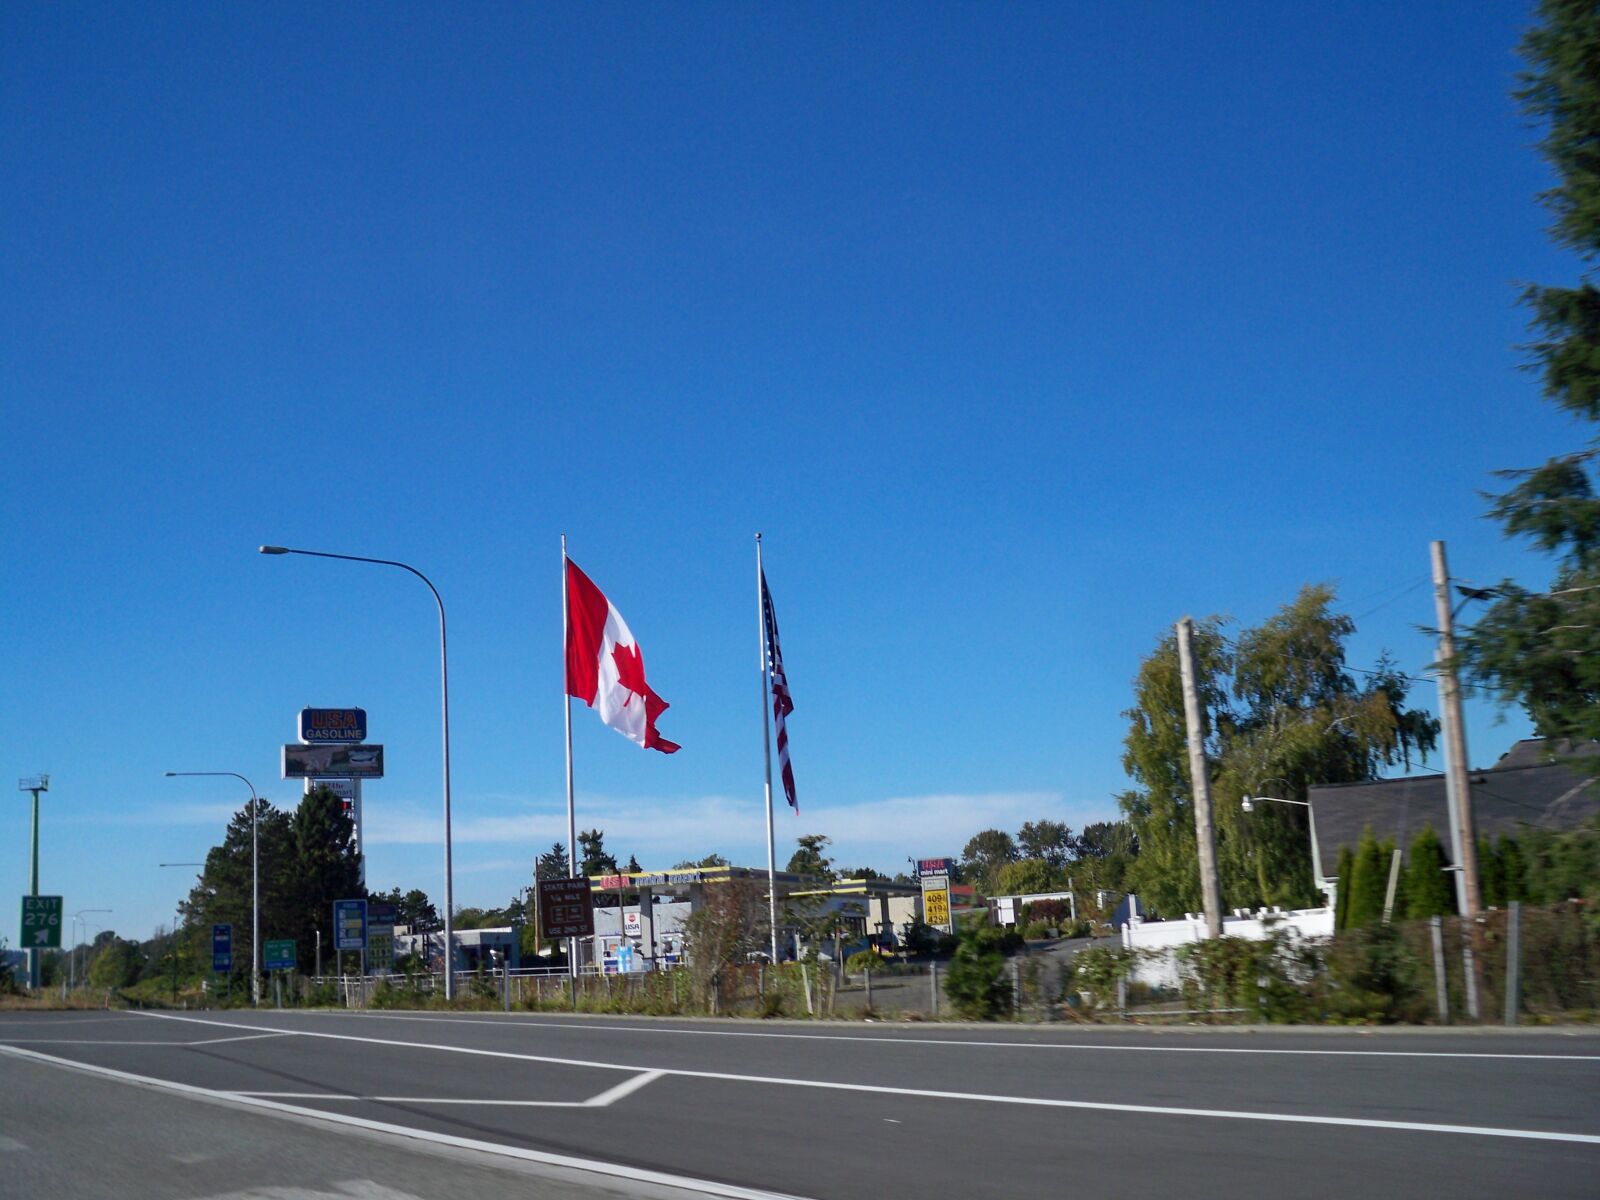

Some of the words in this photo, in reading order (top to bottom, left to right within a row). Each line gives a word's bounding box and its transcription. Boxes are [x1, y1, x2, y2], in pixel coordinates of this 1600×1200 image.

[312, 711, 357, 728] USA
[306, 730, 362, 739] GASOLINE
[921, 859, 945, 870] USA
[600, 875, 630, 889] USA
[26, 899, 58, 910] EXIT
[25, 912, 58, 926] 276
[625, 923, 640, 931] USA
